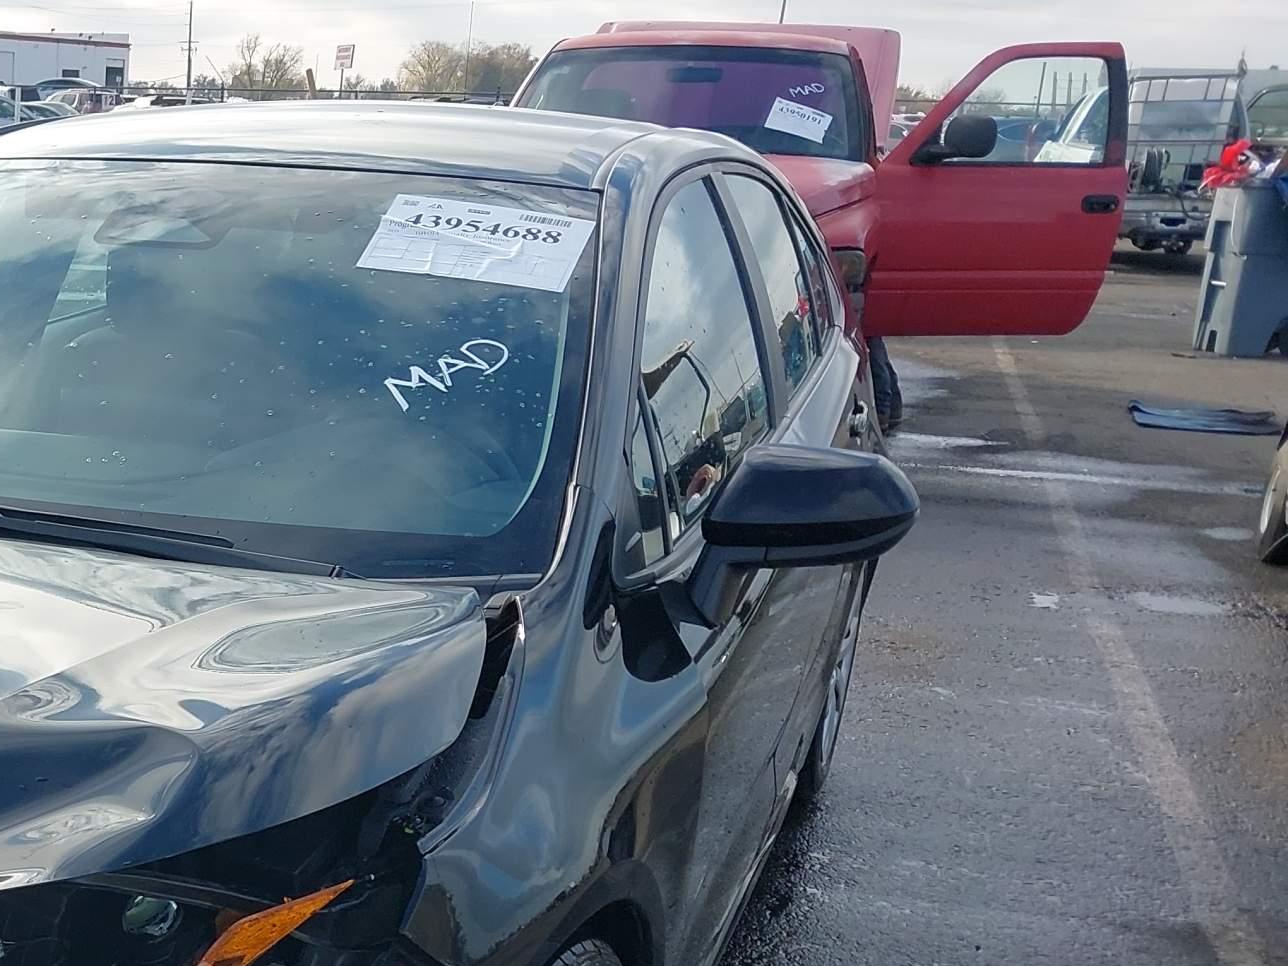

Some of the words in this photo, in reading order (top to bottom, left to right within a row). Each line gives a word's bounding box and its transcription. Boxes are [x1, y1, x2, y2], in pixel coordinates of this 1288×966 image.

[789, 83, 825, 97] MAD
[405, 213, 563, 244] 43954688
[383, 339, 509, 412] MAD
